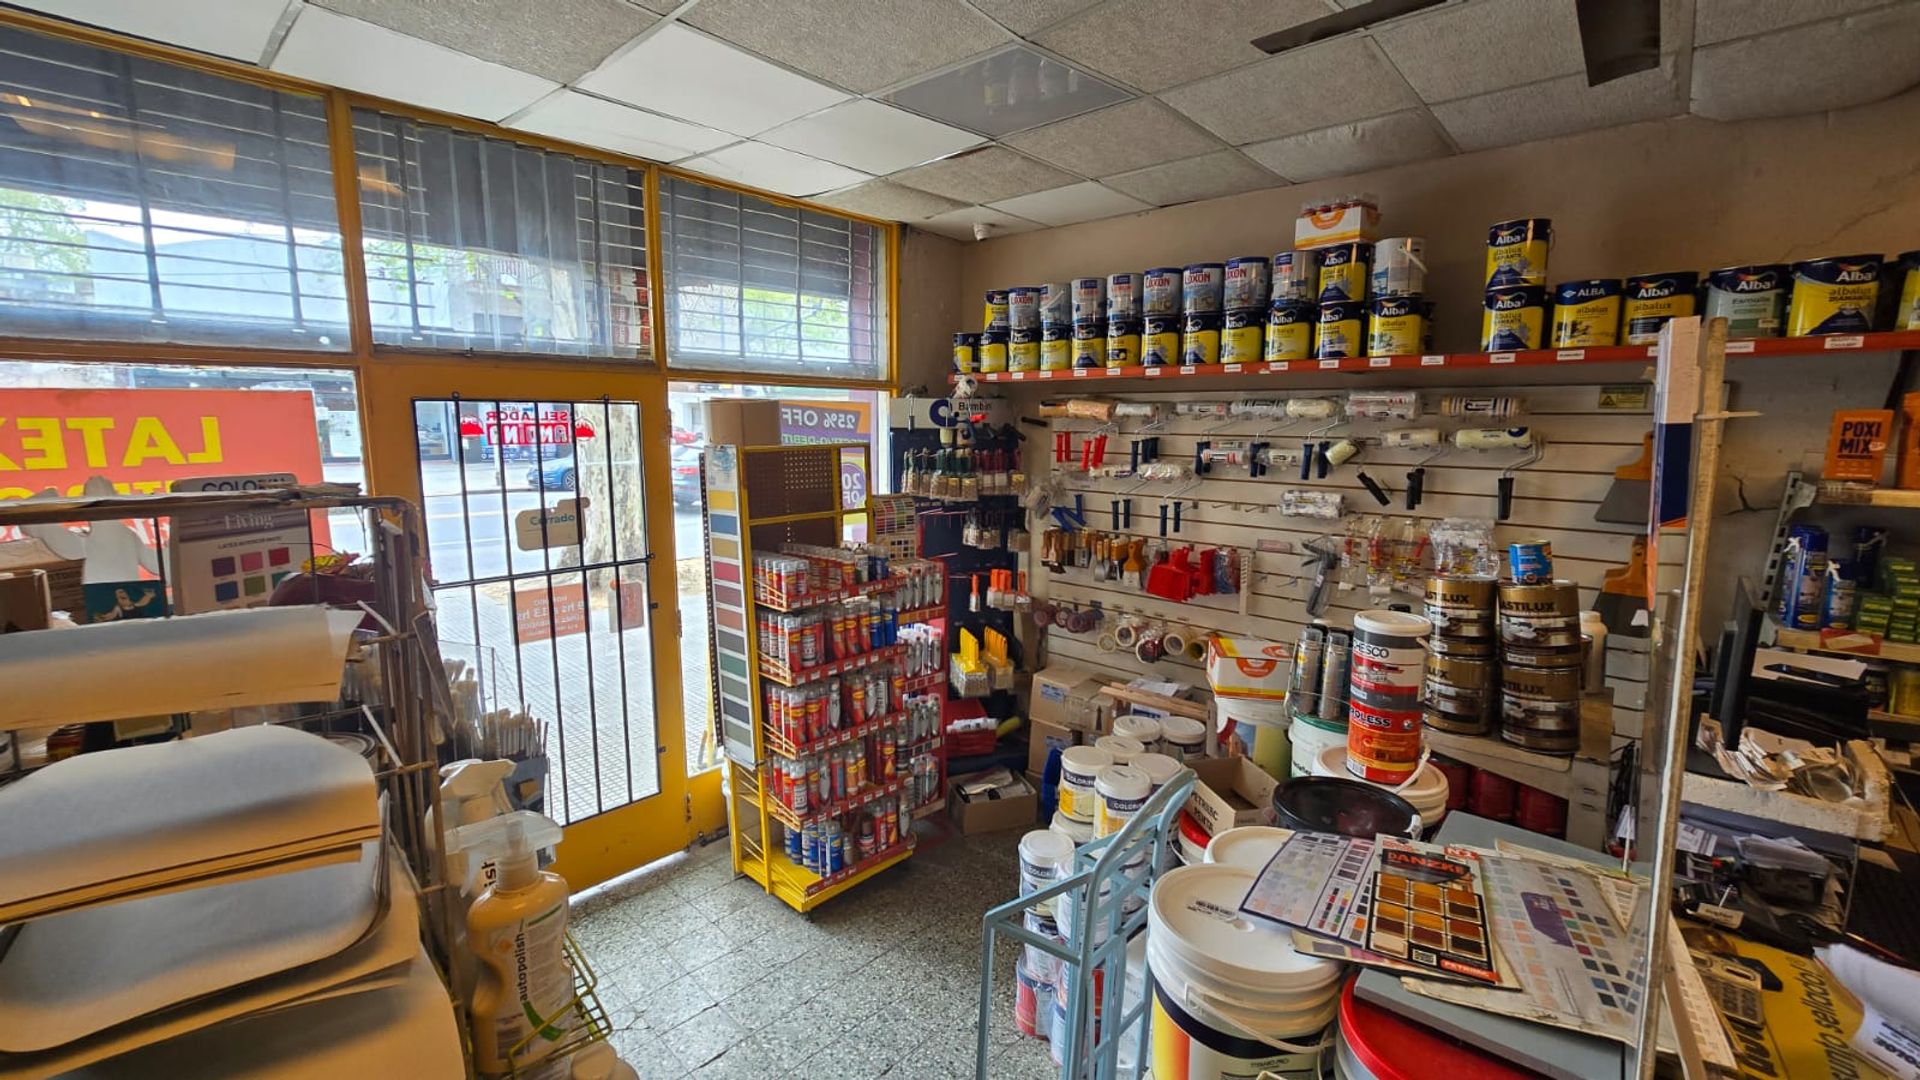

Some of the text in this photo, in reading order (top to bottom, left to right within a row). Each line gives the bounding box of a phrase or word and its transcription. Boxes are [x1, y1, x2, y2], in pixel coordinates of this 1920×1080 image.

[1495, 234, 1521, 246] Alba
[1835, 270, 1874, 283] Alba
[1736, 280, 1772, 292] Alba
[1577, 288, 1606, 298] ALBA
[1637, 287, 1669, 299] Alba
[1495, 299, 1521, 310] Alba
[1380, 306, 1405, 317] Alba
[1841, 421, 1882, 438] POXI
[1838, 438, 1872, 455] MIX
[224, 513, 274, 530] Living
[518, 932, 528, 1003] autopolish
